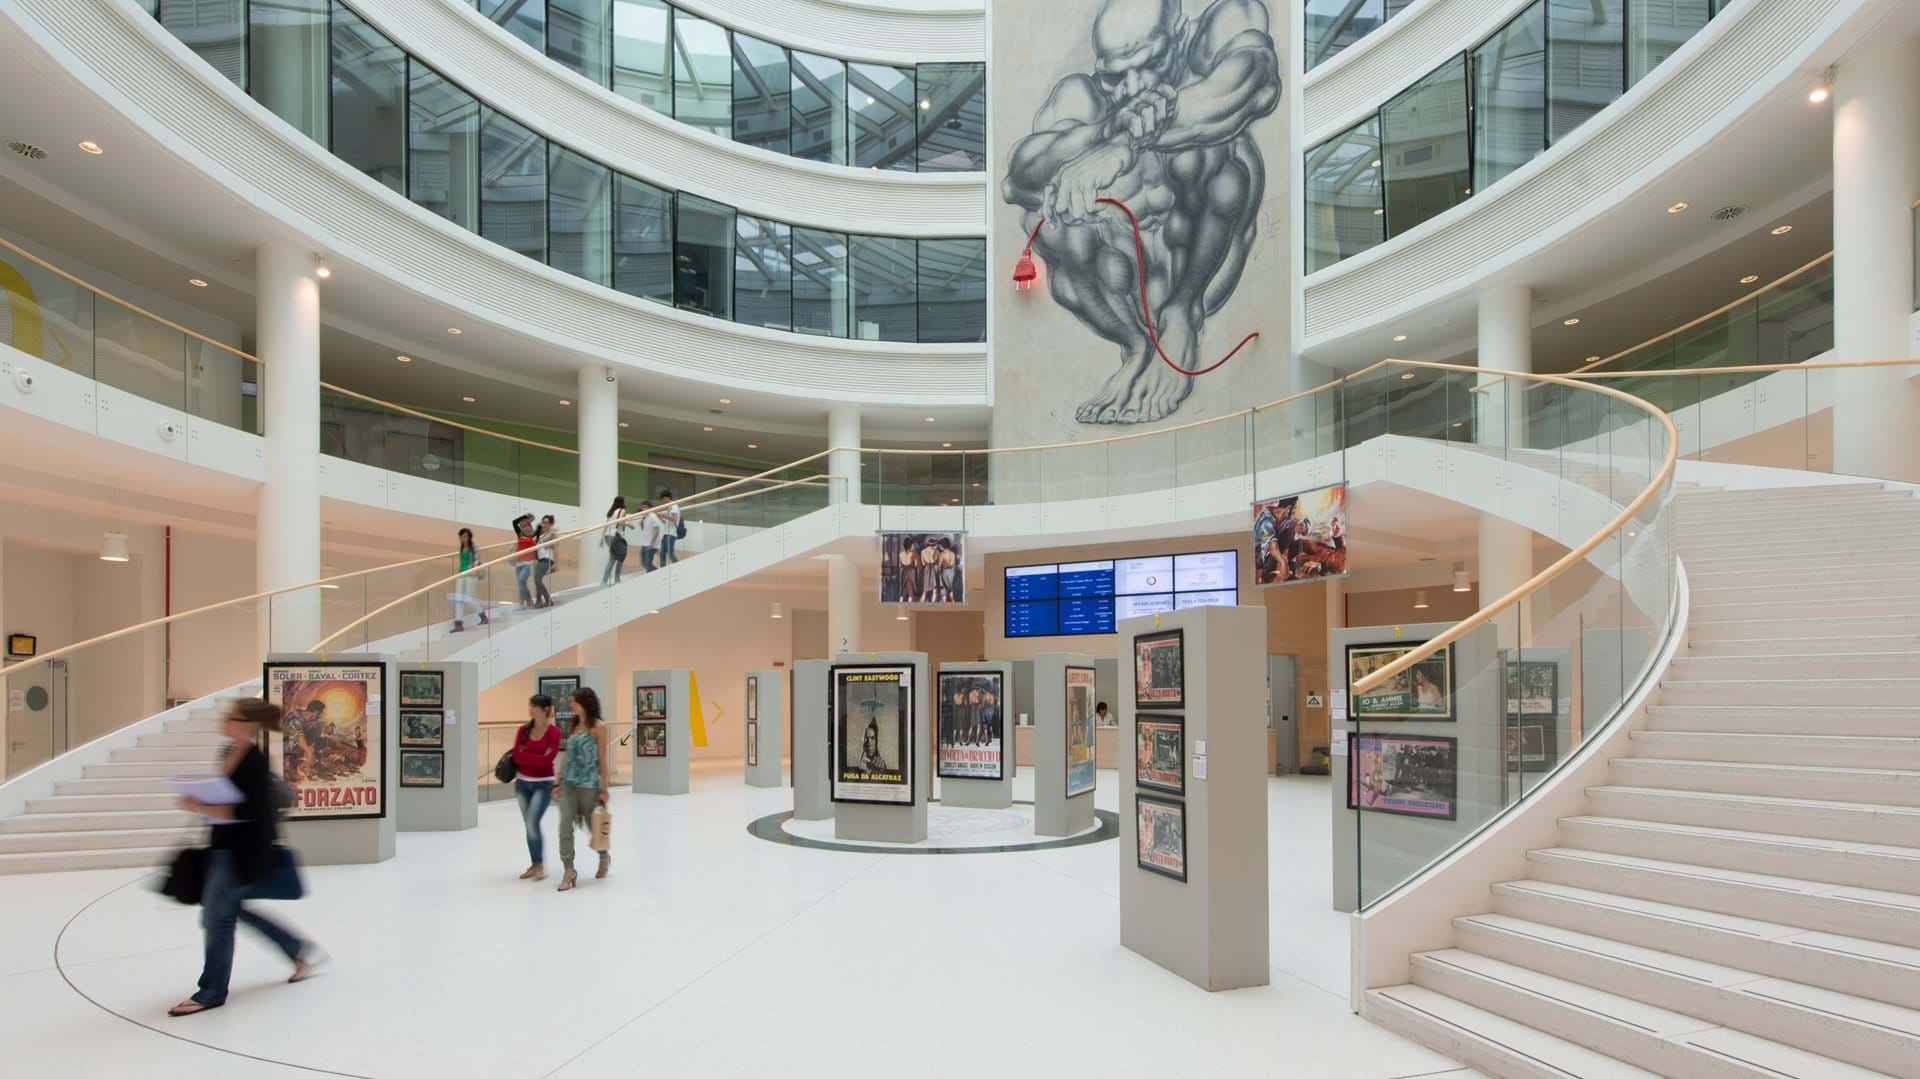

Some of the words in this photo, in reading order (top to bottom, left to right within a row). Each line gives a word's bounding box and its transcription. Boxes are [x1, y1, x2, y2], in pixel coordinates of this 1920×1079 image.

[342, 672, 377, 680] CORTEZ
[864, 674, 899, 682] EASTWOOD
[1381, 694, 1403, 703] ANNIE
[293, 786, 377, 807] FORZATO
